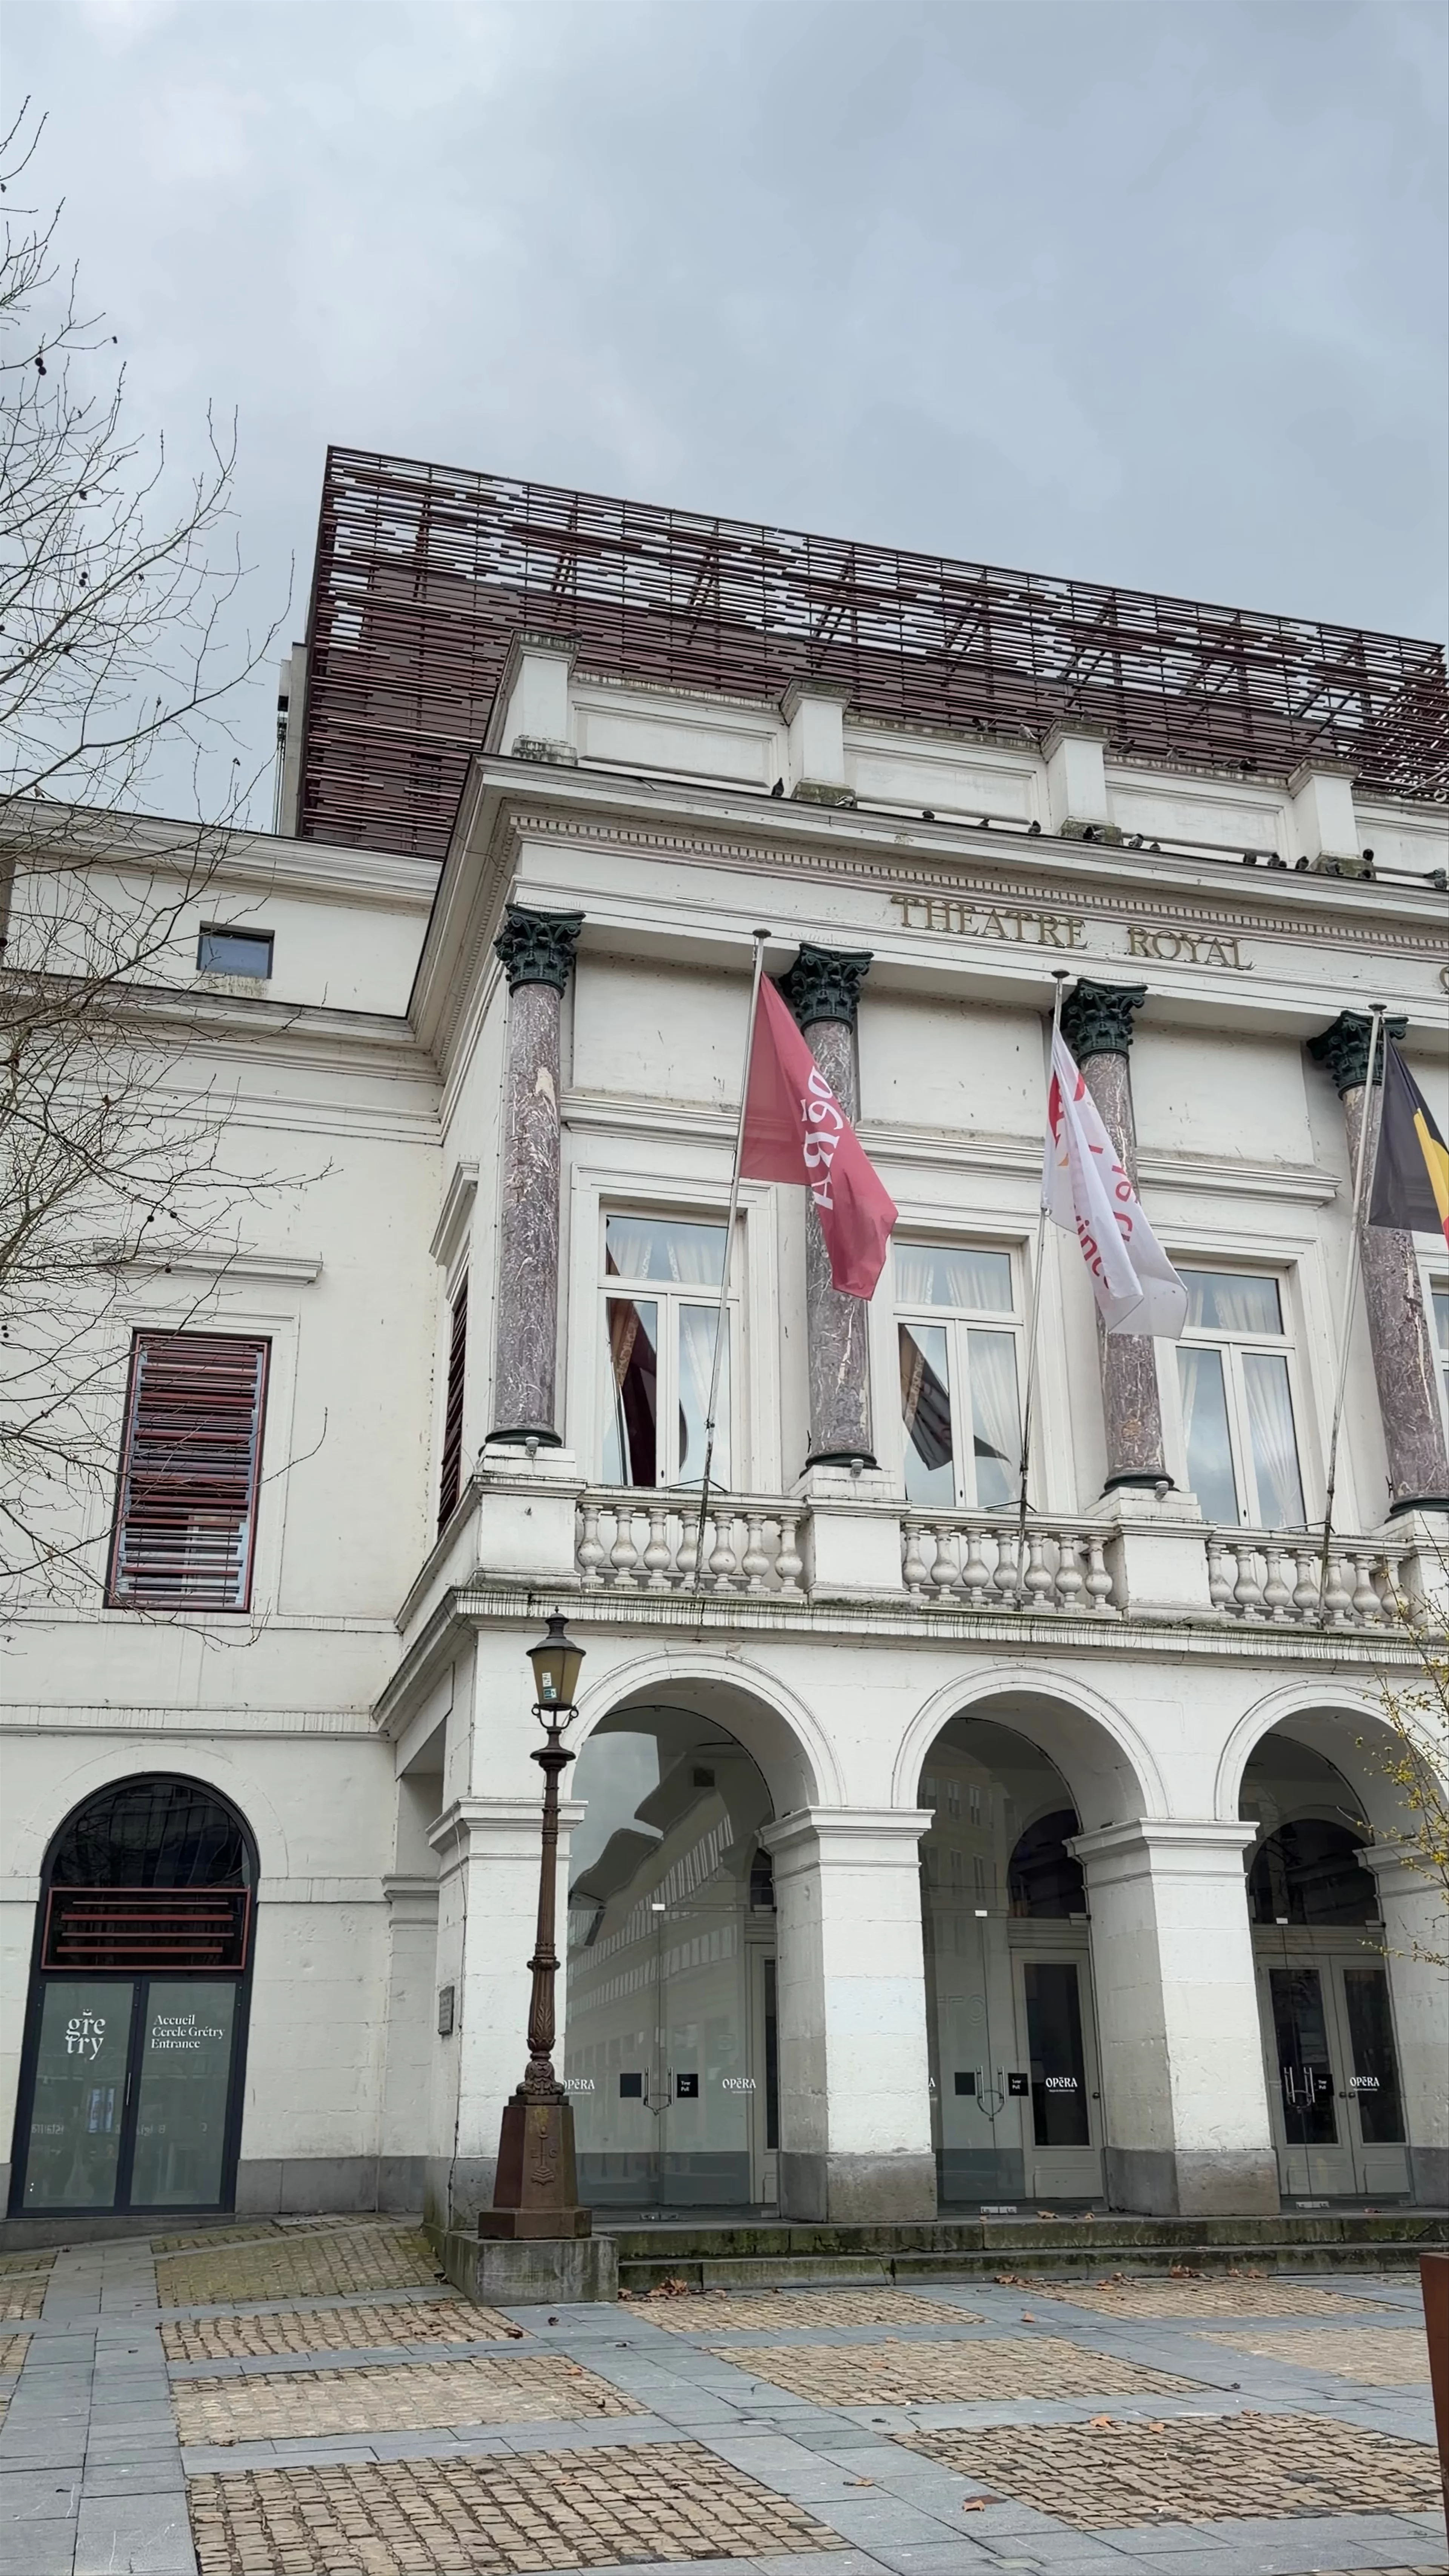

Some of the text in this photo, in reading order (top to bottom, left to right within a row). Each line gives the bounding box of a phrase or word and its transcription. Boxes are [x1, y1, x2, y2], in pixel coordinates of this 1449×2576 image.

[891, 894, 1256, 970] THEATRE ROYAL
[154, 2015, 195, 2025] Accueil
[152, 2026, 225, 2039] Cercle Grétry
[151, 2038, 201, 2049] Entrance
